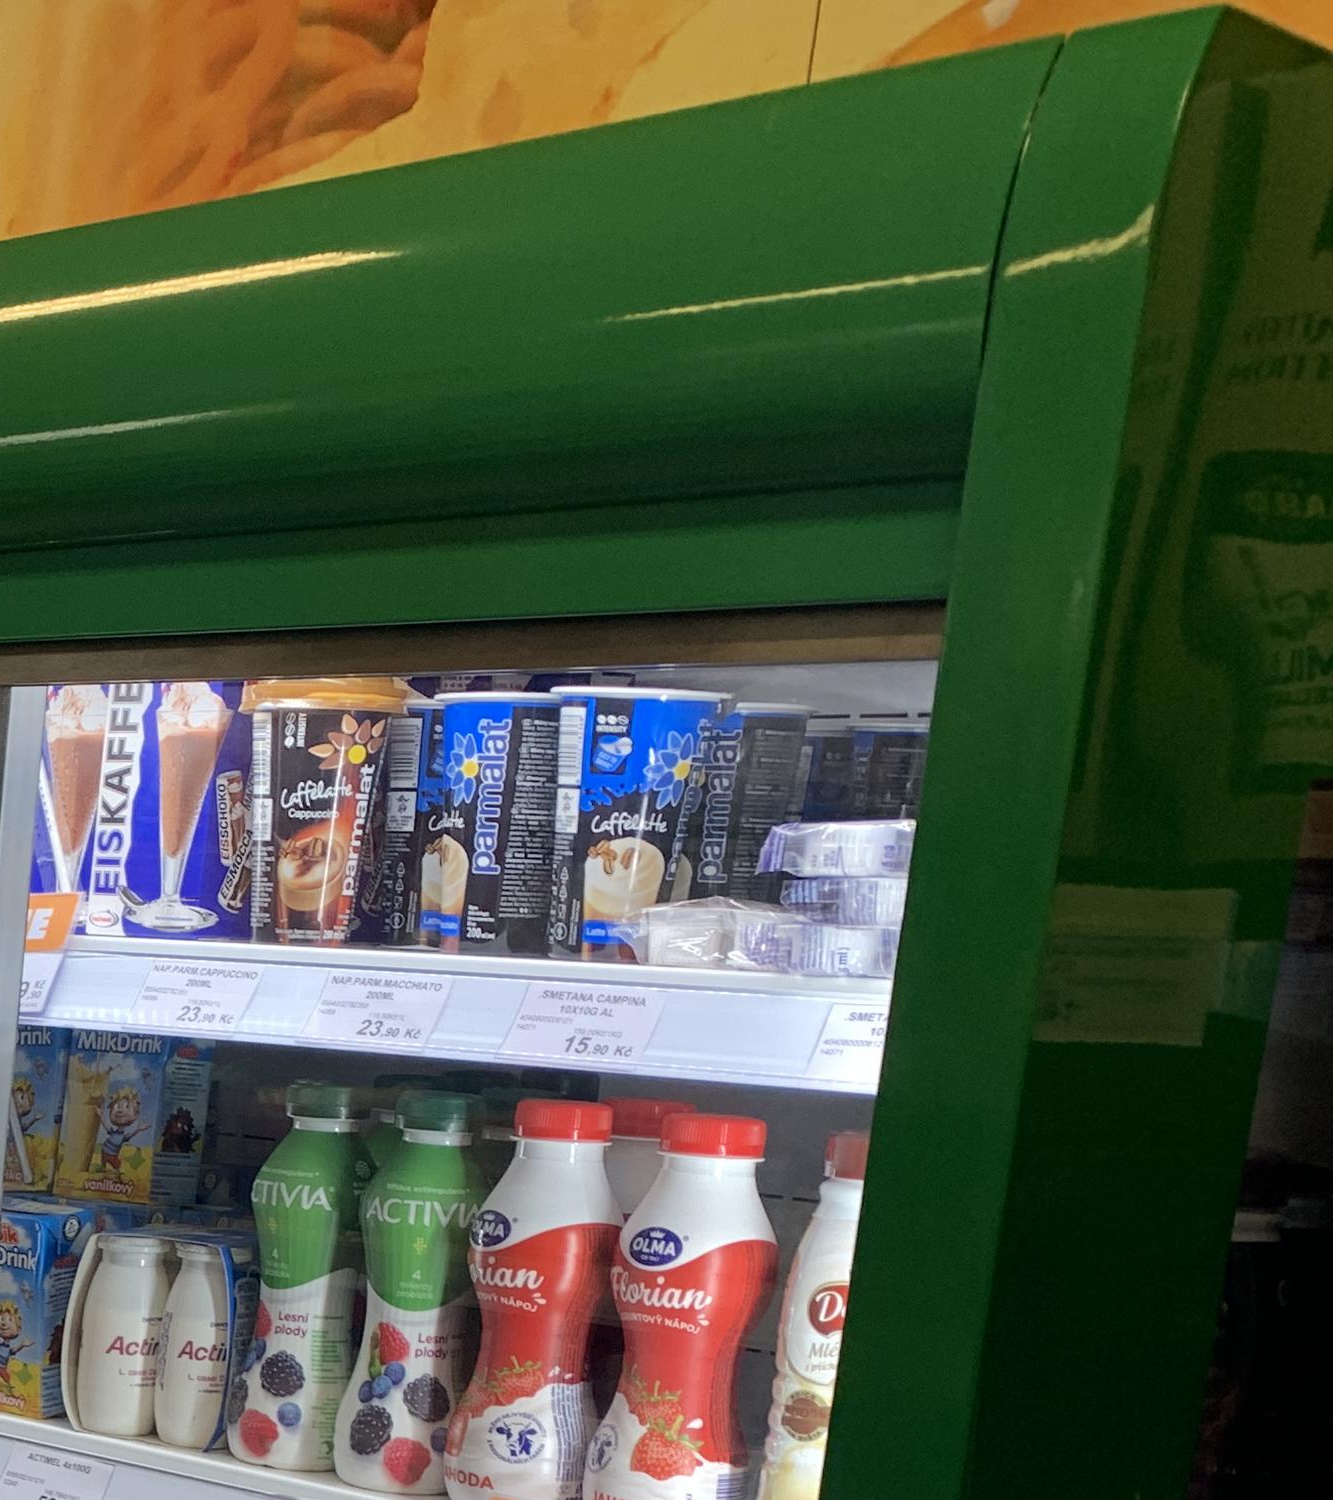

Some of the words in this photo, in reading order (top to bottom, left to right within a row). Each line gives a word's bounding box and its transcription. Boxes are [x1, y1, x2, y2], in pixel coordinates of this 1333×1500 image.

[472, 719, 512, 875] parmalat
[597, 995, 647, 1009] CAMPINA
[176, 1006, 216, 1024] 23,90
[219, 1013, 234, 1025] Kč
[356, 1019, 398, 1039] 23,90
[403, 1027, 421, 1040] Kč
[77, 1030, 163, 1054] MilkDrink
[564, 1035, 609, 1056] 15,90
[614, 1046, 633, 1058] Kč
[633, 1236, 677, 1257] OLMA
[610, 1265, 712, 1311] Florian
[278, 1312, 309, 1323] Lesní
[274, 1325, 307, 1338] plody
[418, 1334, 448, 1344] Lesní
[415, 1347, 448, 1360] plody
[27, 1452, 60, 1467] ACTIMEL
